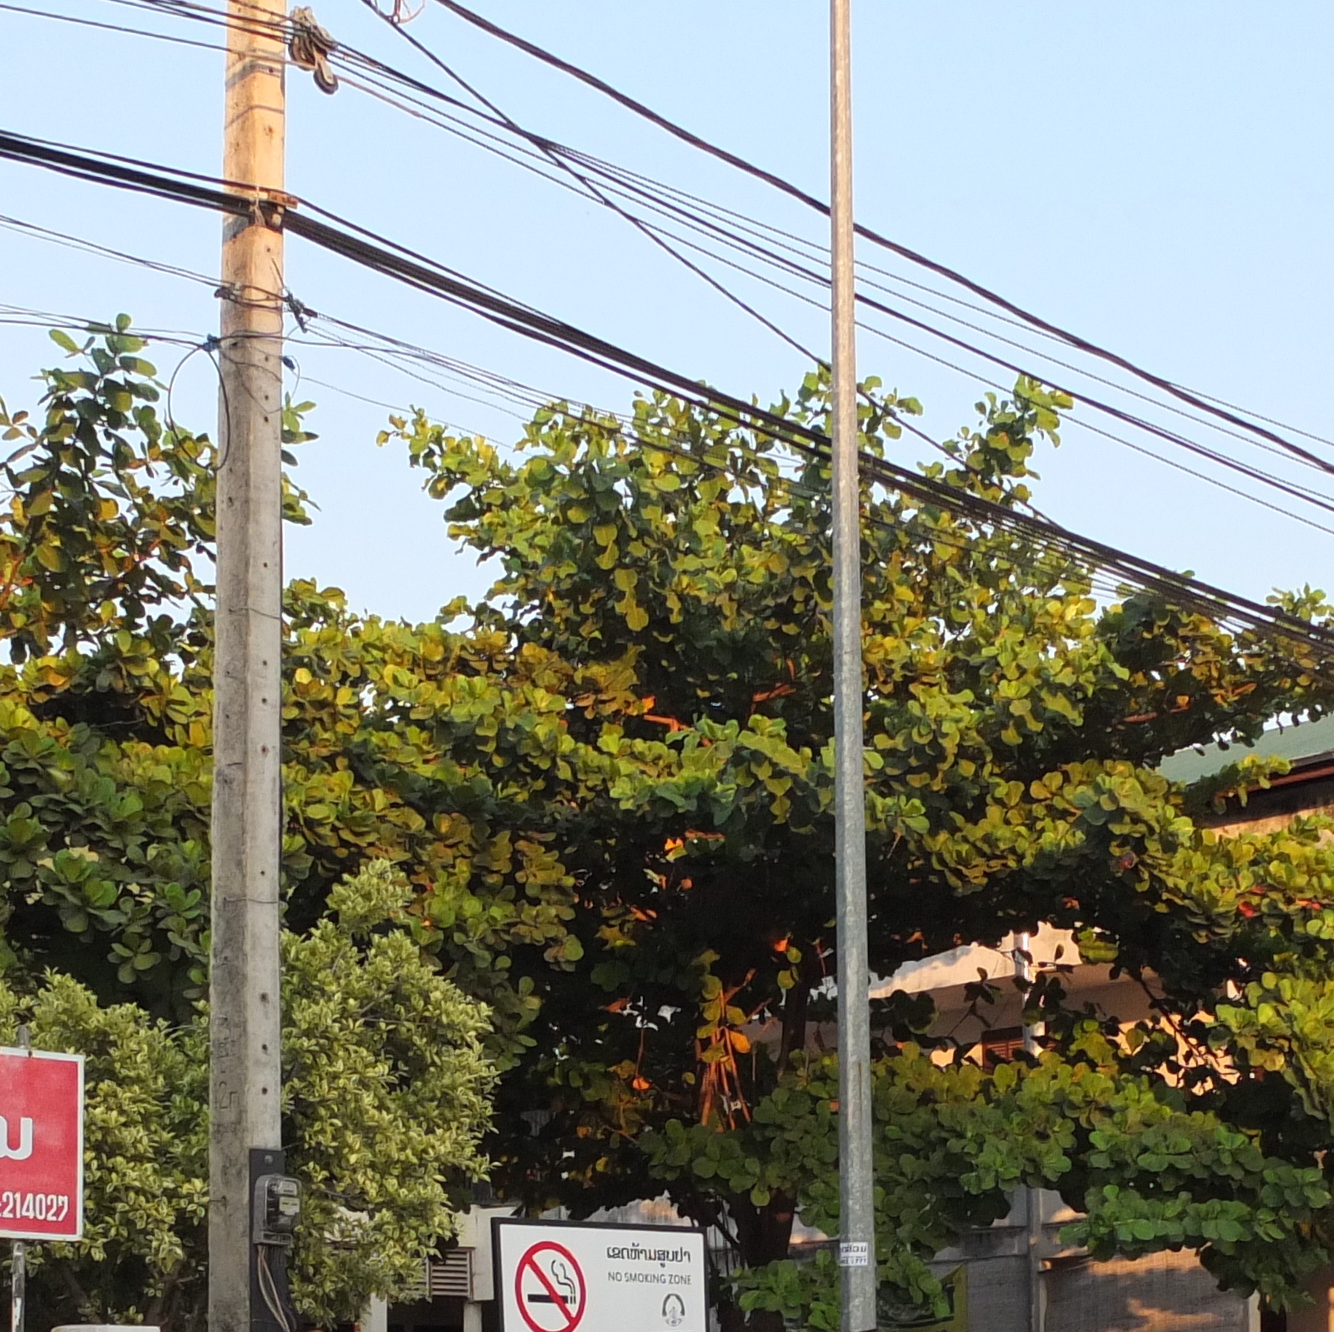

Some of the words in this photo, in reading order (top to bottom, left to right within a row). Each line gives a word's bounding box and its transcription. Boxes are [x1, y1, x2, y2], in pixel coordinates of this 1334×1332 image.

[607, 1271, 623, 1283] NO
[624, 1272, 667, 1285] SMOKING
[668, 1274, 692, 1286] ZONE
